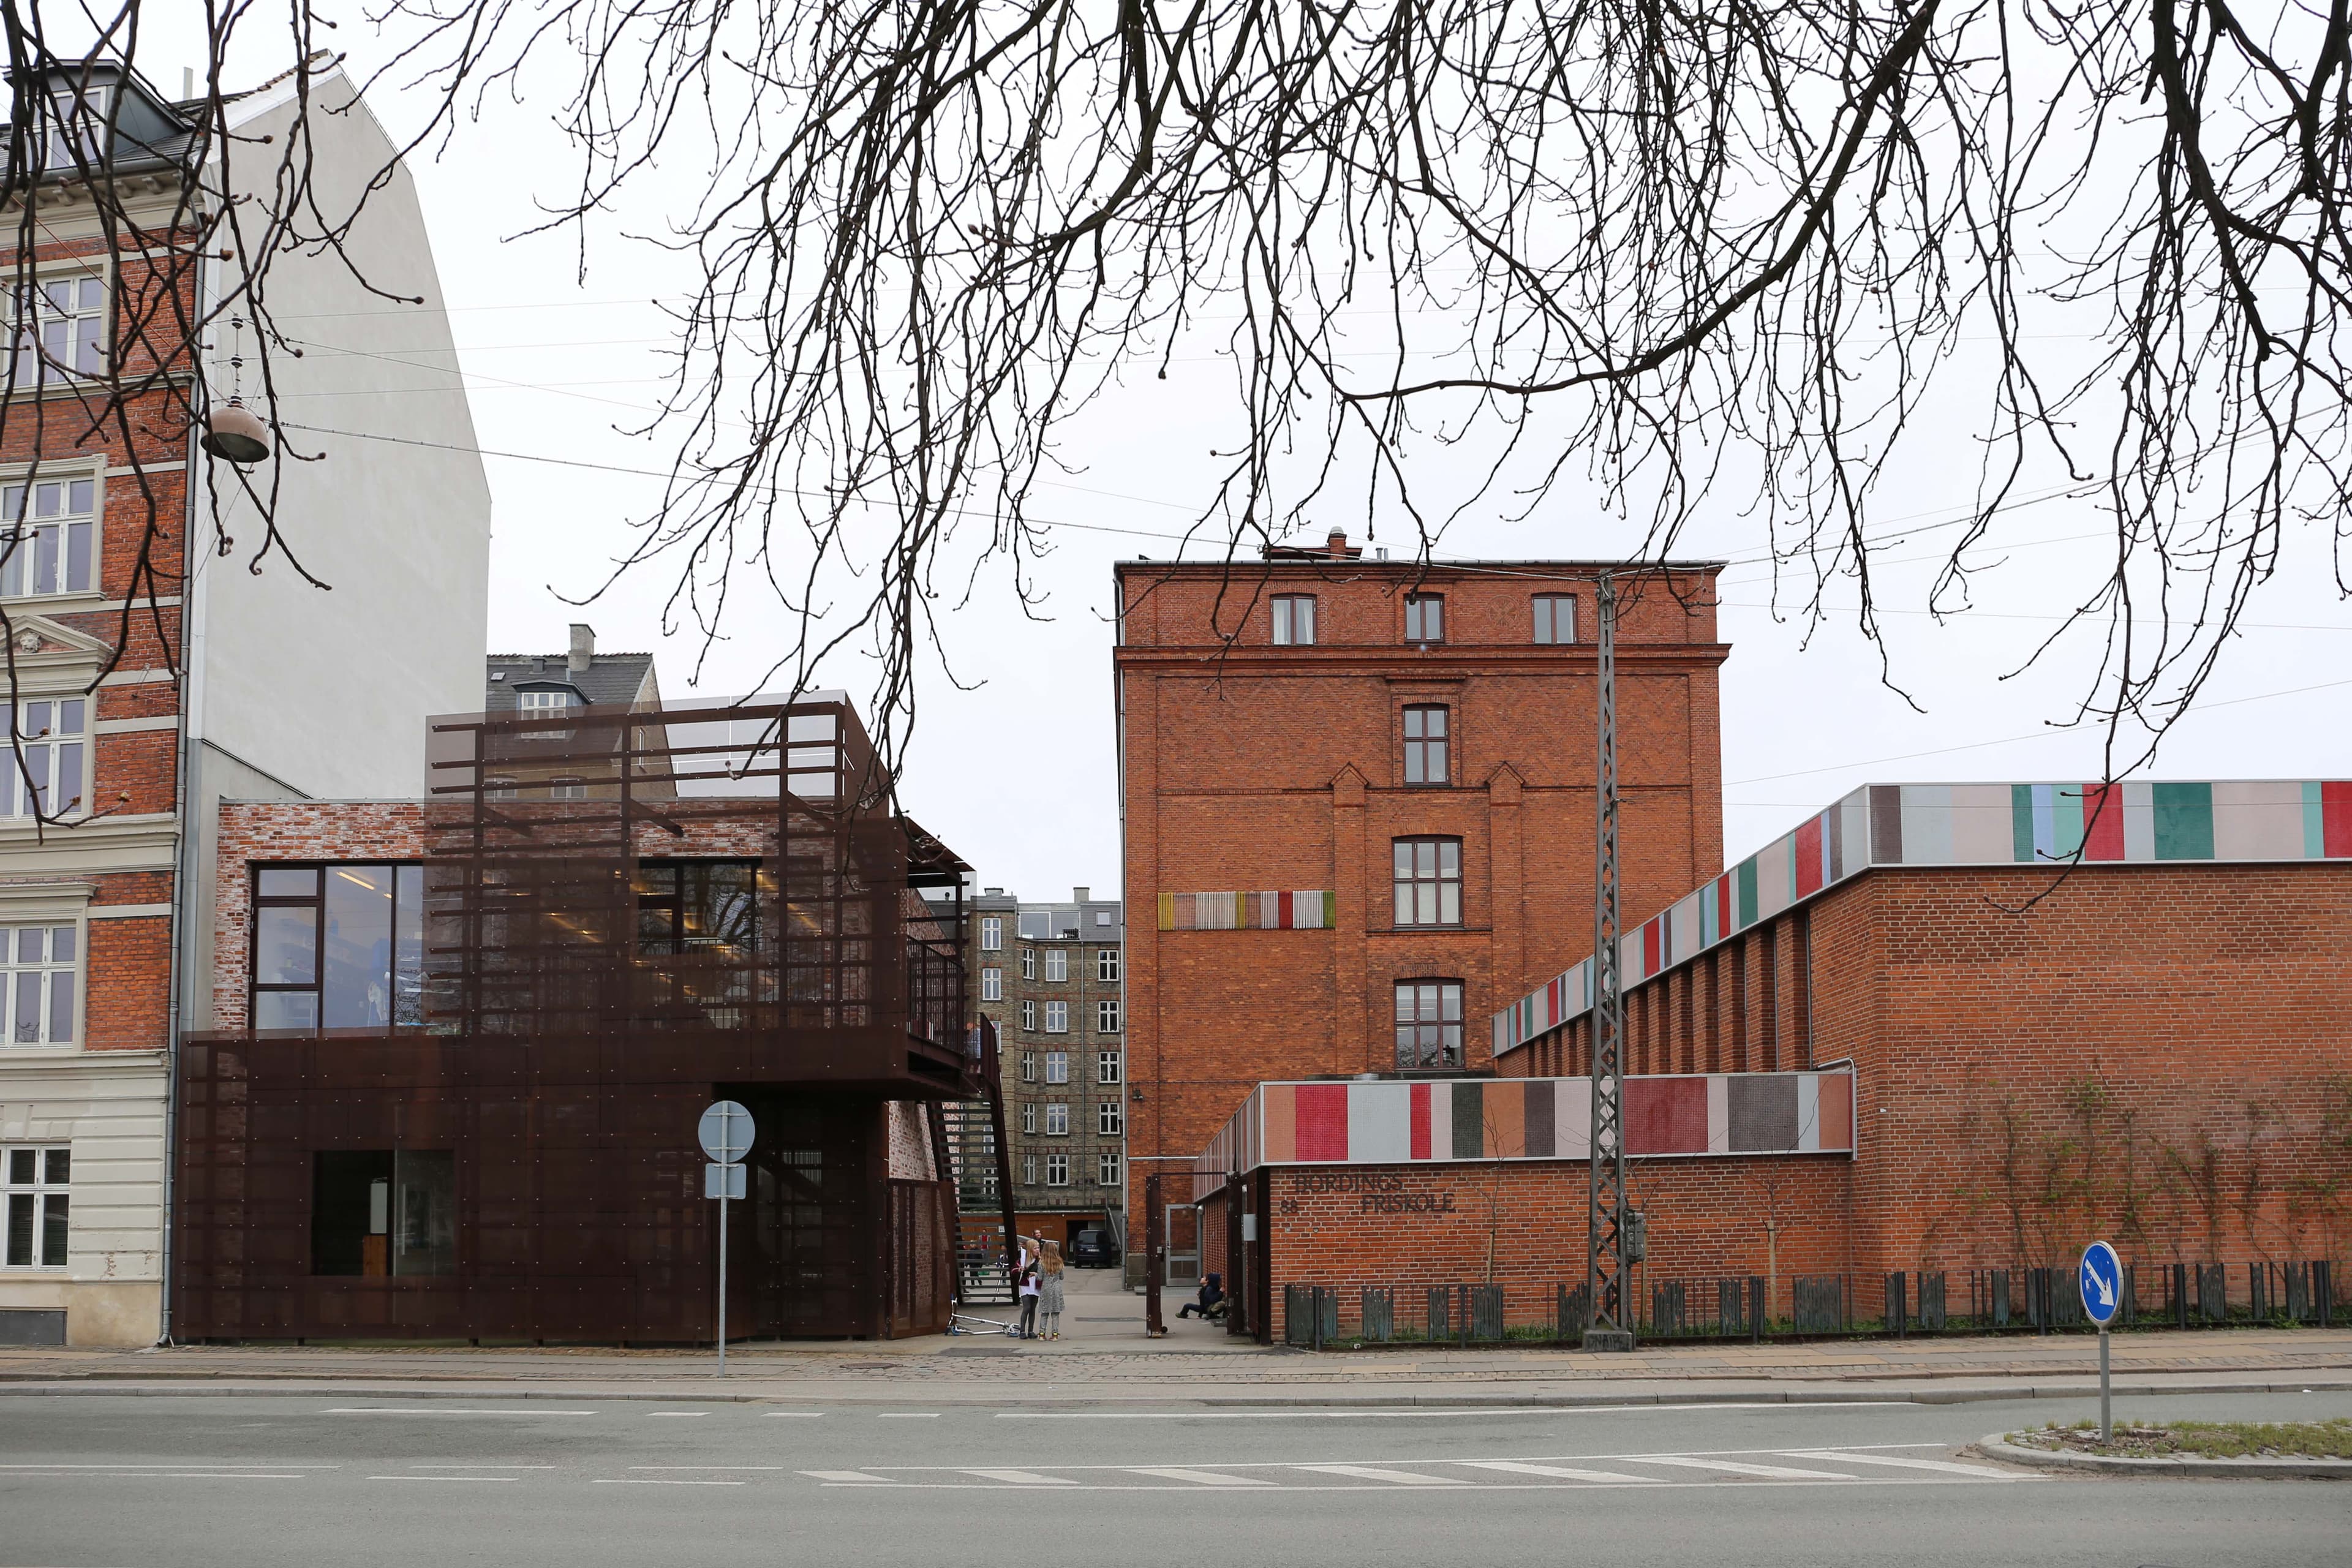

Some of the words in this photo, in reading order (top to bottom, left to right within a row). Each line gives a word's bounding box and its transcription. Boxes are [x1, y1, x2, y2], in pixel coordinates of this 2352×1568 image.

[1295, 1174, 1403, 1191] BORDINGS
[1280, 1200, 1298, 1213] 88
[1362, 1193, 1455, 1212] FRISKOLE
